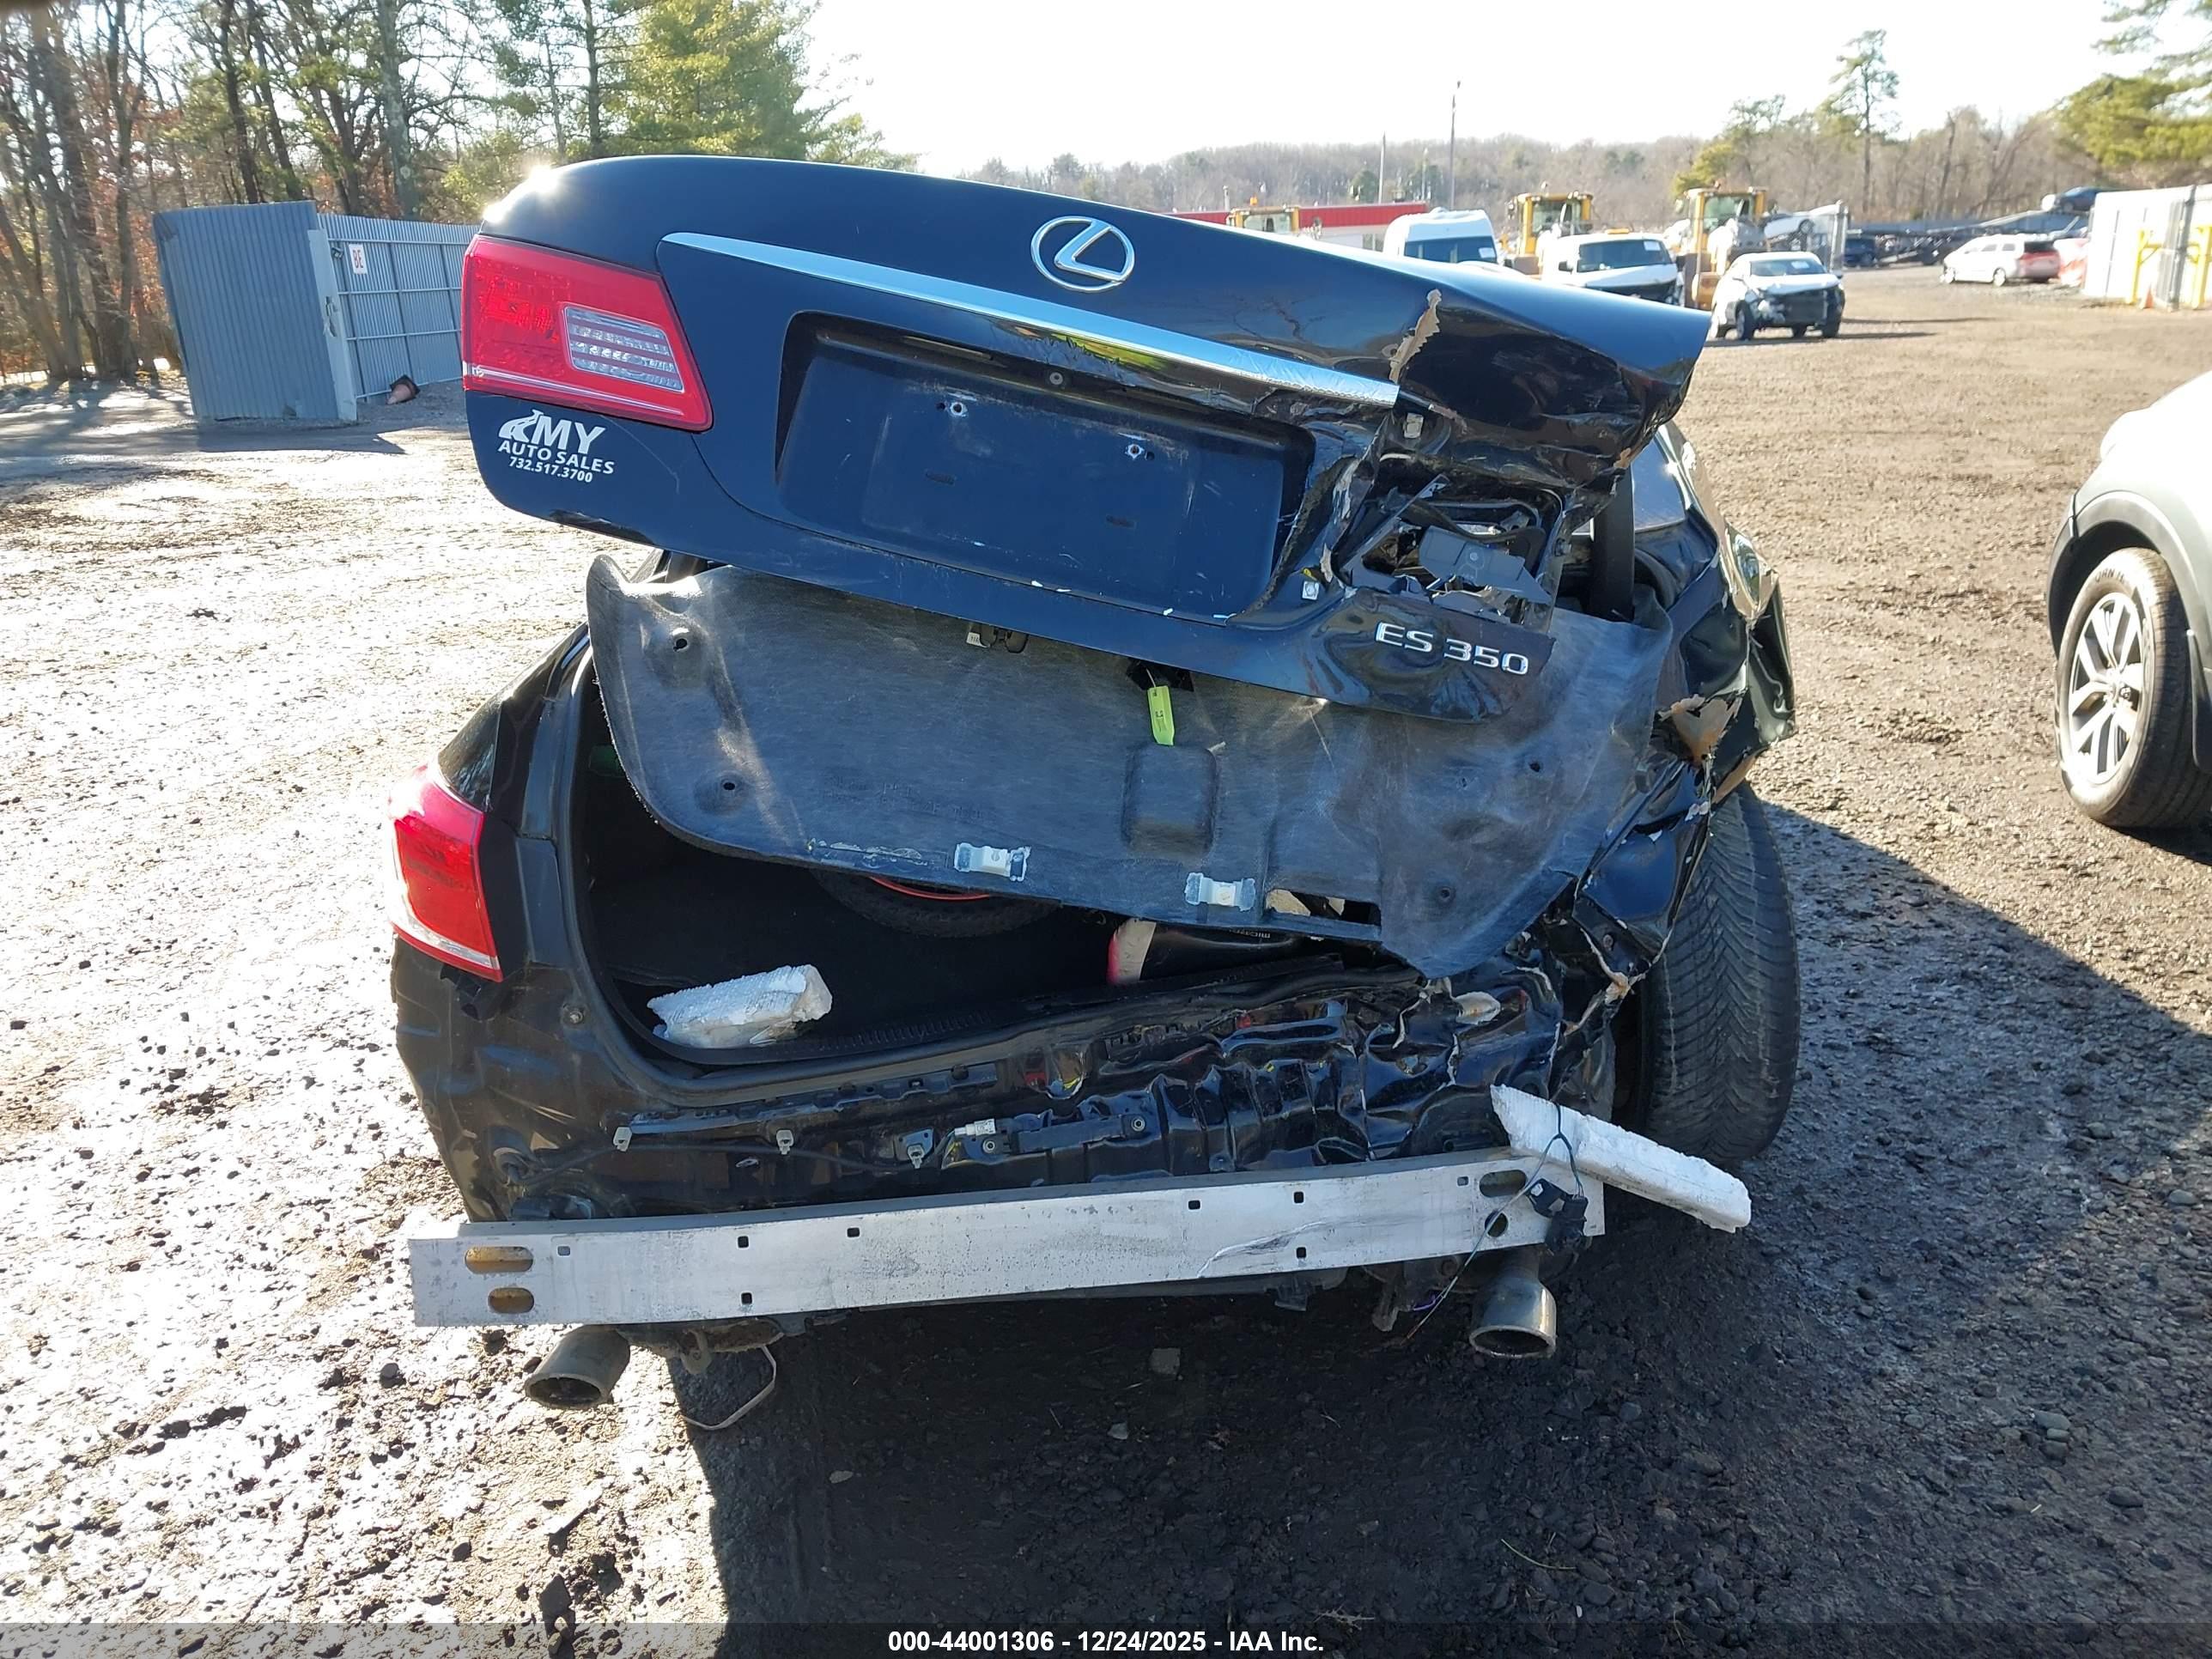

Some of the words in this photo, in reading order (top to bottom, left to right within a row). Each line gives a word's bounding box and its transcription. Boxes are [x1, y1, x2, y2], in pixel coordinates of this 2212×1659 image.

[498, 440, 552, 461] AUTO
[555, 451, 615, 474] SALES
[509, 456, 593, 483] 732.517.3700
[1376, 622, 1433, 653] ES
[1443, 638, 1528, 675] 350
